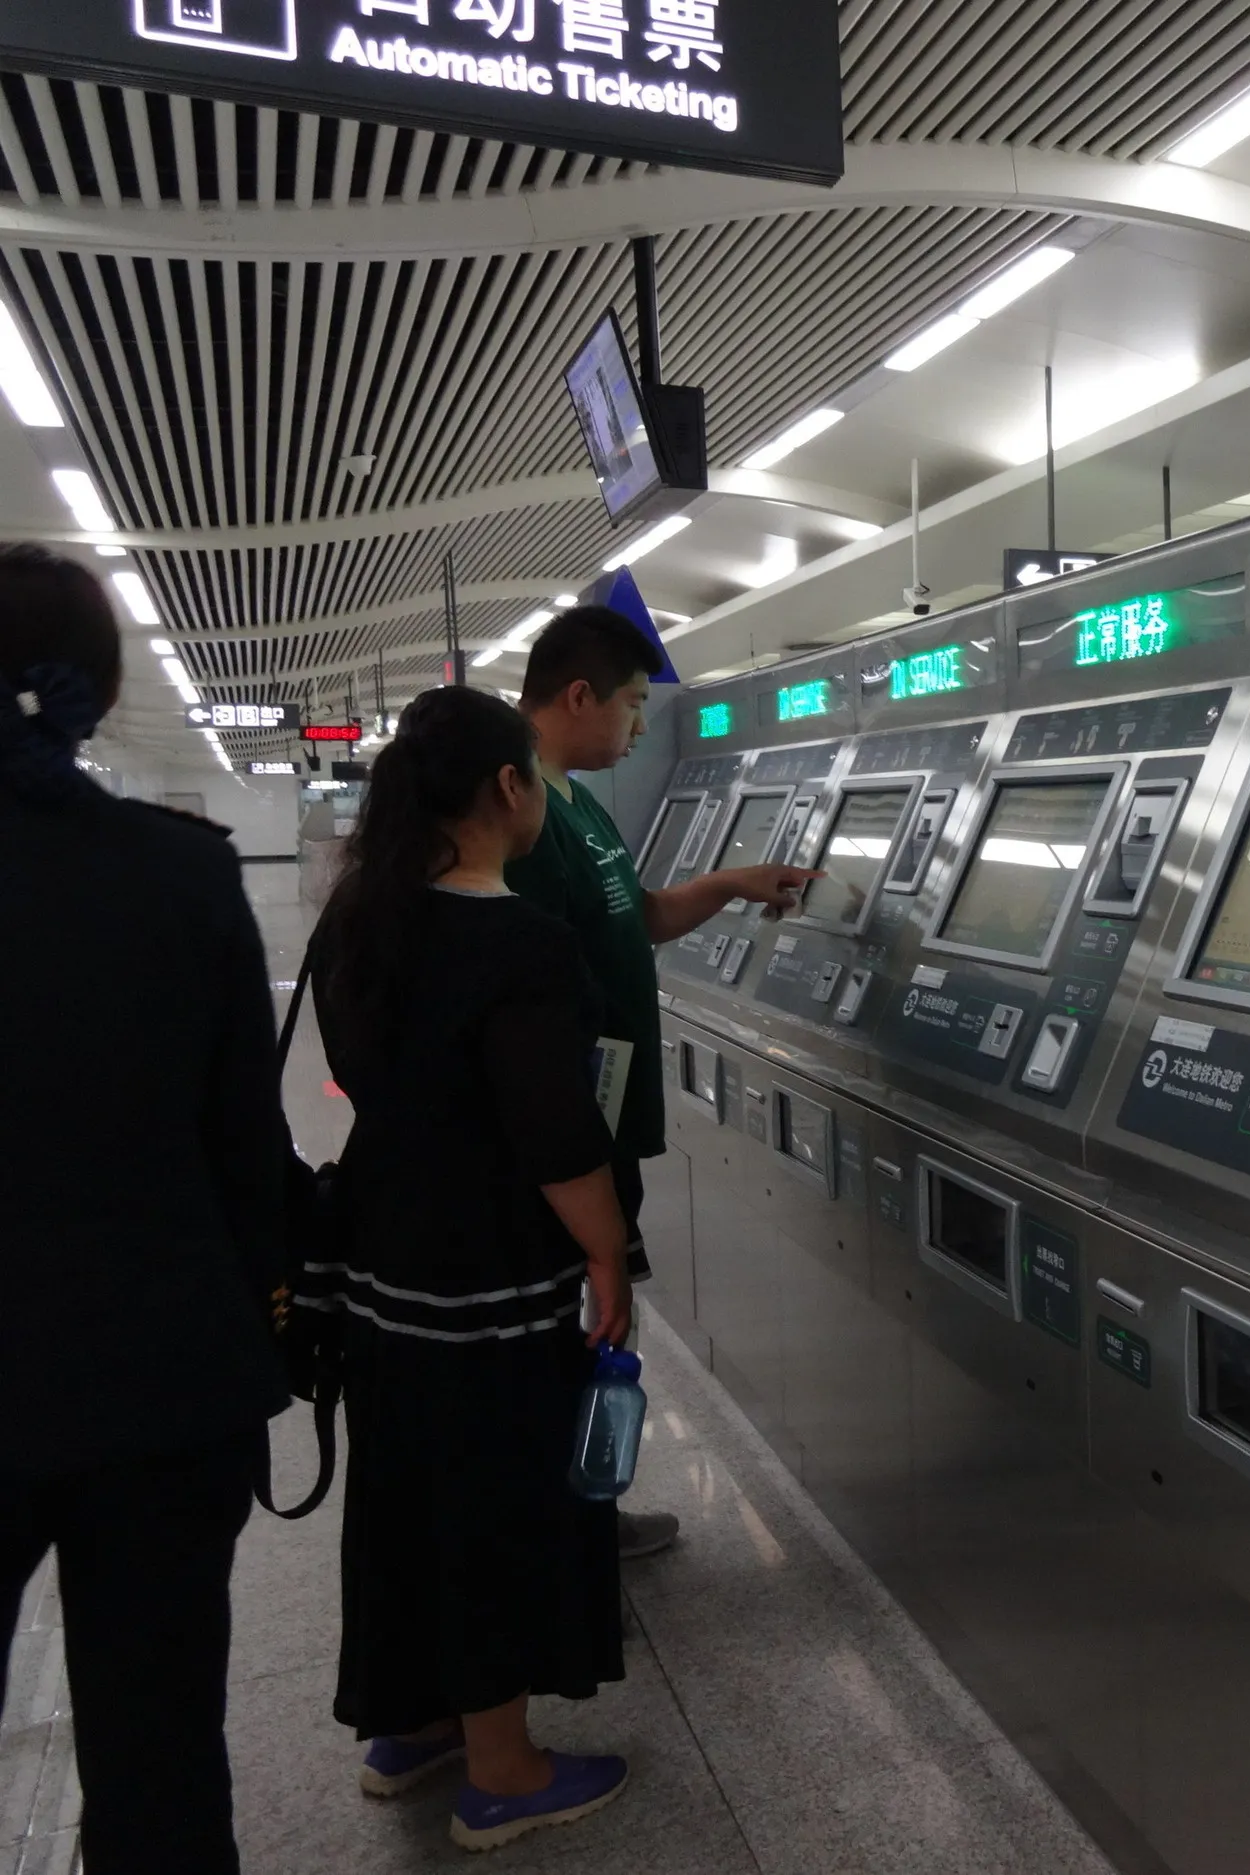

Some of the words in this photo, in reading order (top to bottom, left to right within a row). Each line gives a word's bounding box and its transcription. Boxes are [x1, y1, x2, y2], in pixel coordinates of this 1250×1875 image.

[329, 26, 554, 97] Automatic
[557, 62, 739, 133] Ticketing
[1076, 594, 1169, 665] 正常服务
[1170, 1056, 1244, 1093] 大连地铁欢迎您
